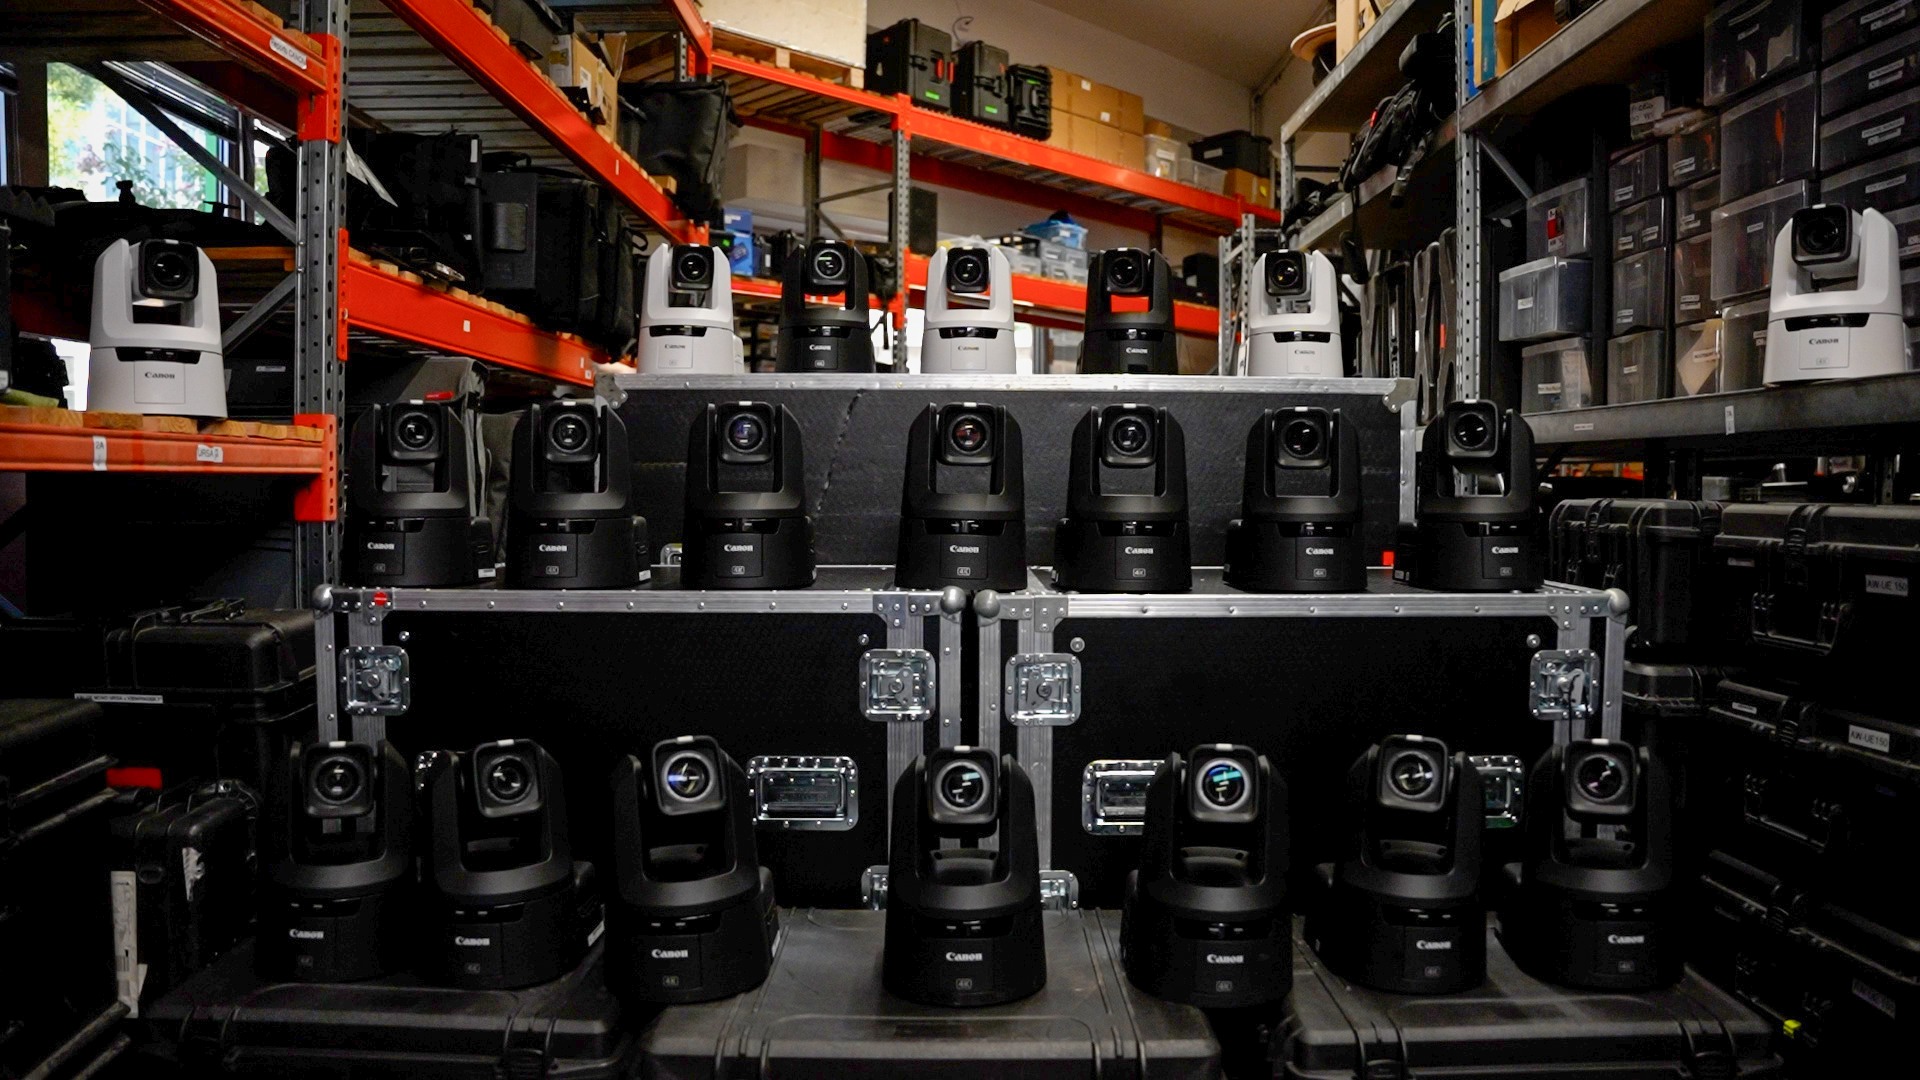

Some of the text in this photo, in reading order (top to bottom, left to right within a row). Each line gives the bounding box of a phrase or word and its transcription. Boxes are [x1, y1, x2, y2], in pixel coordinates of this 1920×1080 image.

[1808, 338, 1839, 346] Canon
[144, 371, 176, 379] Canon
[367, 541, 395, 550] Canon
[538, 544, 568, 552] Canon
[723, 544, 754, 552] Canon
[949, 544, 980, 554] Canon
[1124, 546, 1154, 555] Canon
[1491, 546, 1519, 555] Canon
[1305, 546, 1334, 556] Canon
[289, 928, 324, 939] Canon
[454, 936, 491, 947] Canon
[1607, 934, 1645, 944] Canon
[1415, 939, 1452, 950] Canon
[651, 948, 689, 959] Canon
[945, 951, 983, 962] Canon
[1206, 953, 1244, 964] Canon
